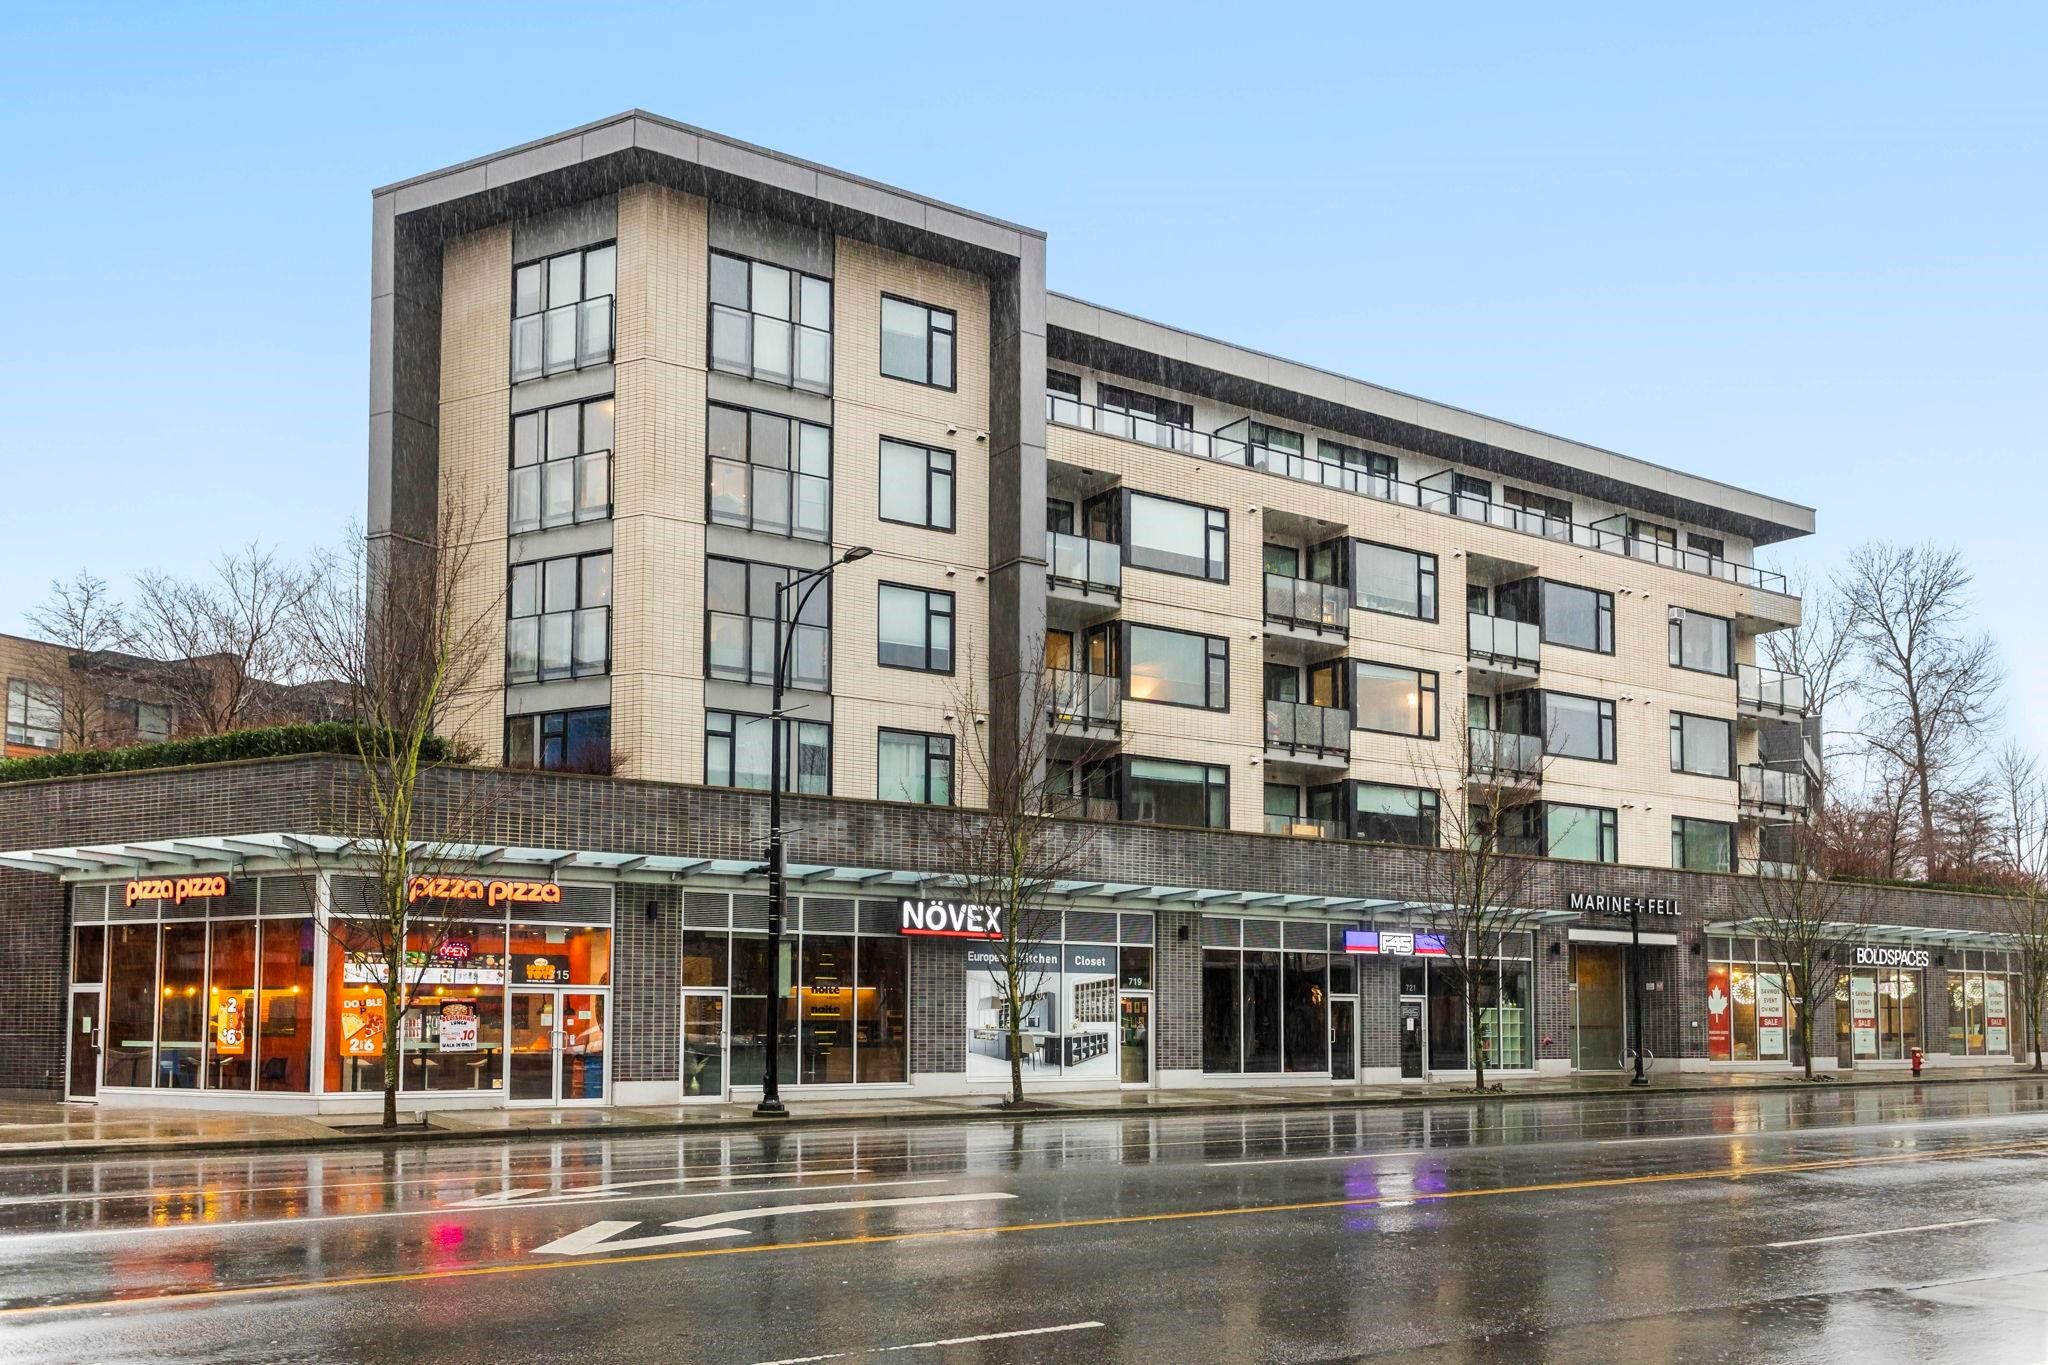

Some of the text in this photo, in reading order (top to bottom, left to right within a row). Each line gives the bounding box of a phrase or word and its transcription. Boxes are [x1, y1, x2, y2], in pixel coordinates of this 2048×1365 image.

[126, 877, 225, 907] pizza pizza
[409, 877, 560, 907] pizza pizza
[1570, 893, 1631, 912] MARINE
[1648, 899, 1682, 915] FELL
[903, 900, 1001, 933] NÖVEX
[439, 946, 468, 957] OPEN
[1856, 947, 1929, 967] BOLDSPACES
[1074, 955, 1106, 967] Closet
[1128, 977, 1142, 986] 719
[227, 997, 237, 1013] 2
[1764, 1018, 1779, 1026] SALE
